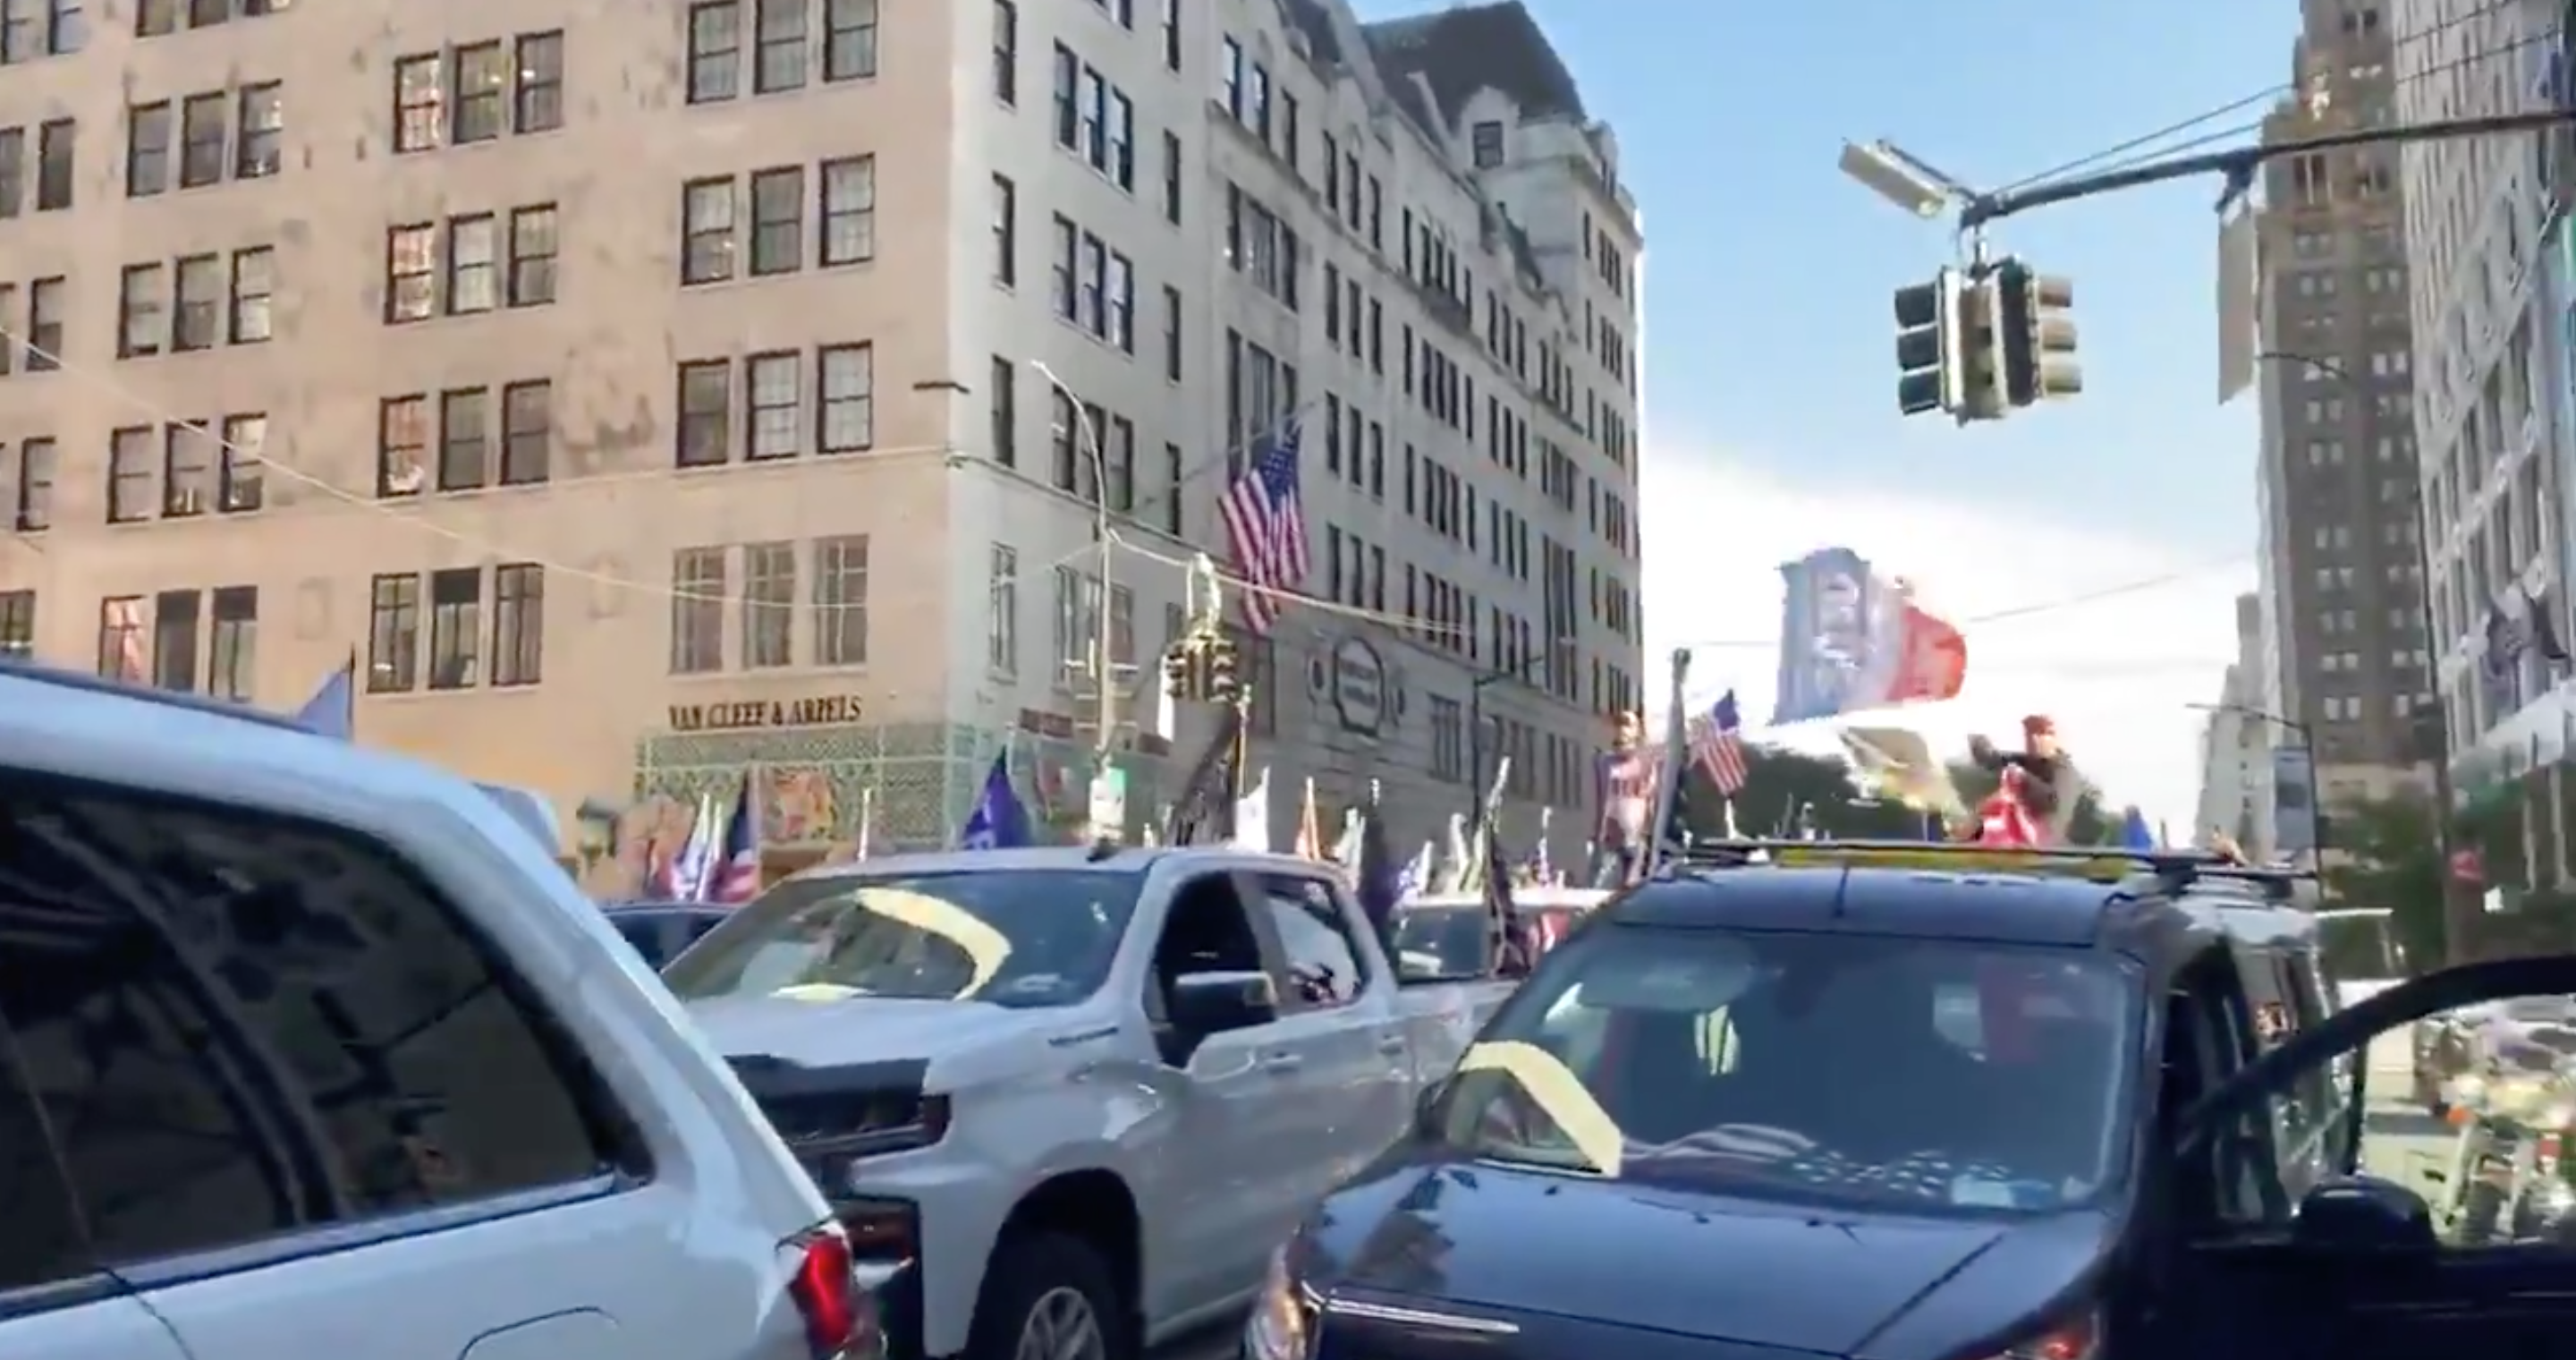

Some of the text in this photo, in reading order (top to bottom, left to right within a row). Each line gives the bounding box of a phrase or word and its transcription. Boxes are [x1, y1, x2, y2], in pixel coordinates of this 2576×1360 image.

[669, 694, 861, 729] VAN CLEEF & ARPELS
